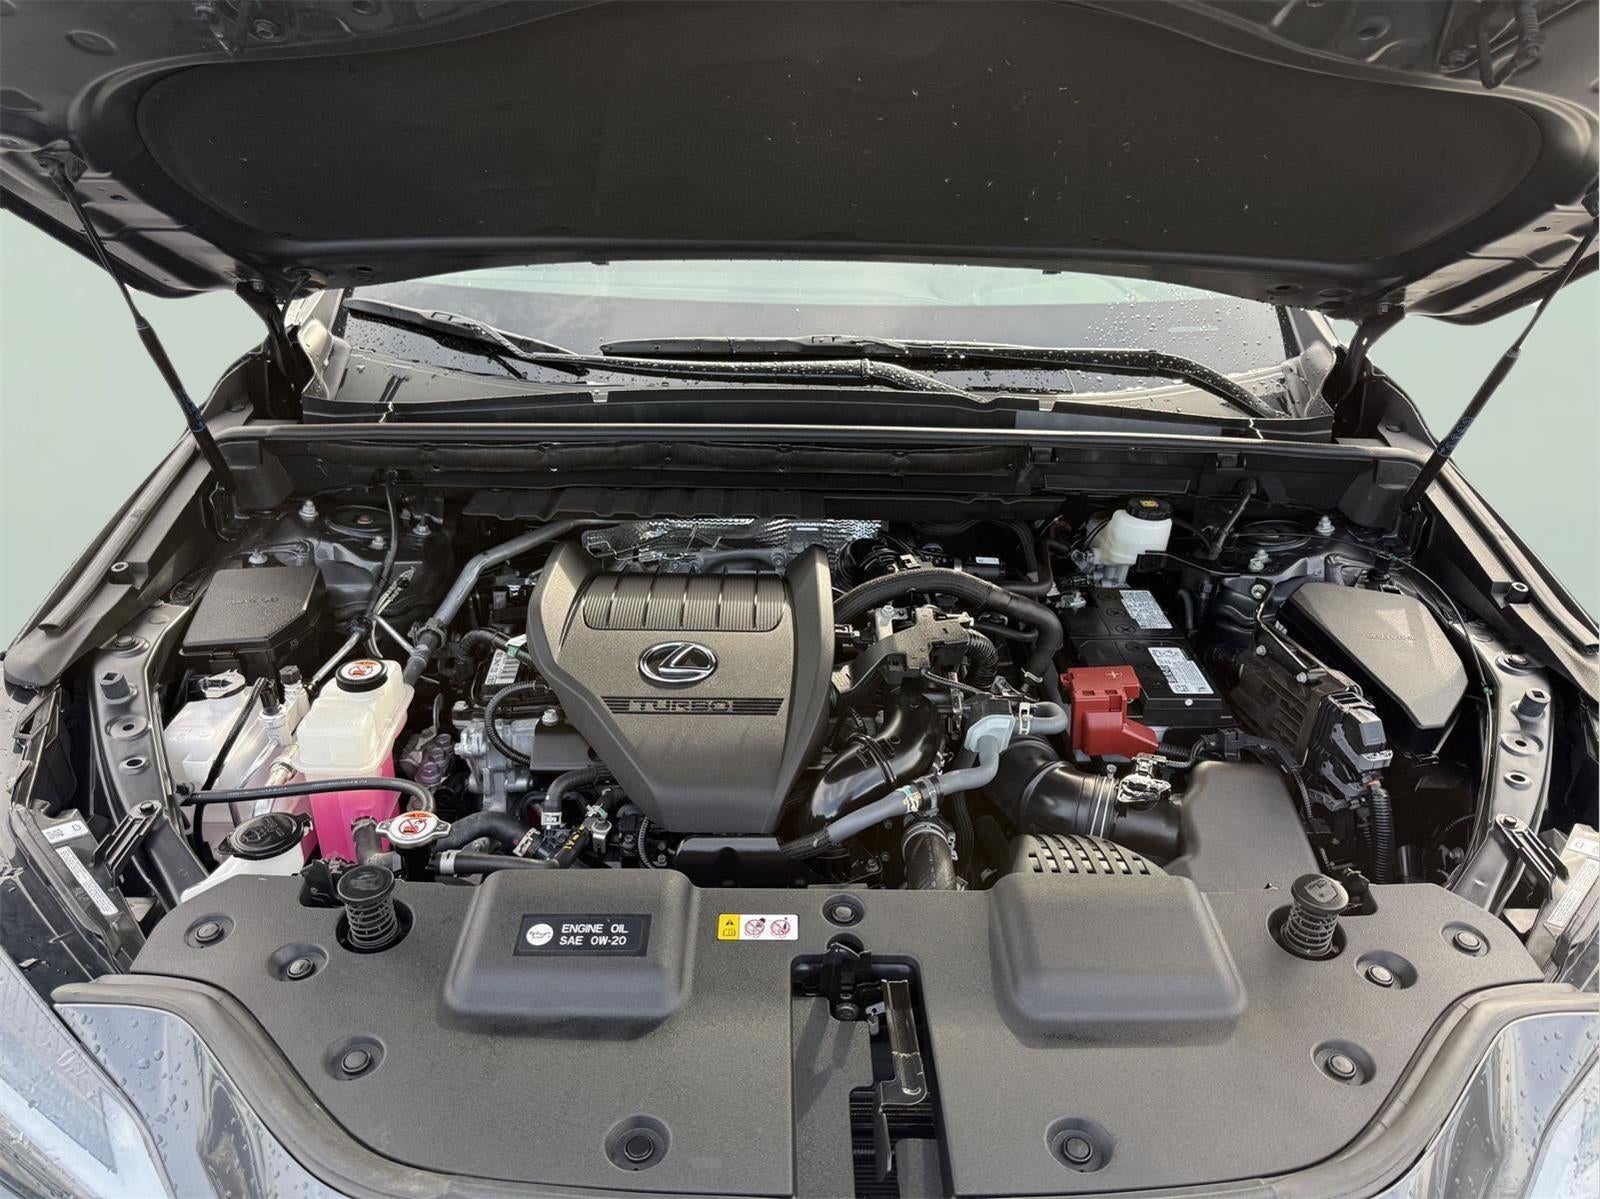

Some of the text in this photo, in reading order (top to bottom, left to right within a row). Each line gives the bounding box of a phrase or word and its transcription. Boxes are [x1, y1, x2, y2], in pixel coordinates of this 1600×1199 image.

[630, 700, 732, 712] TURBO
[561, 923, 629, 934] ENGINE OIL
[559, 935, 584, 946] SAE
